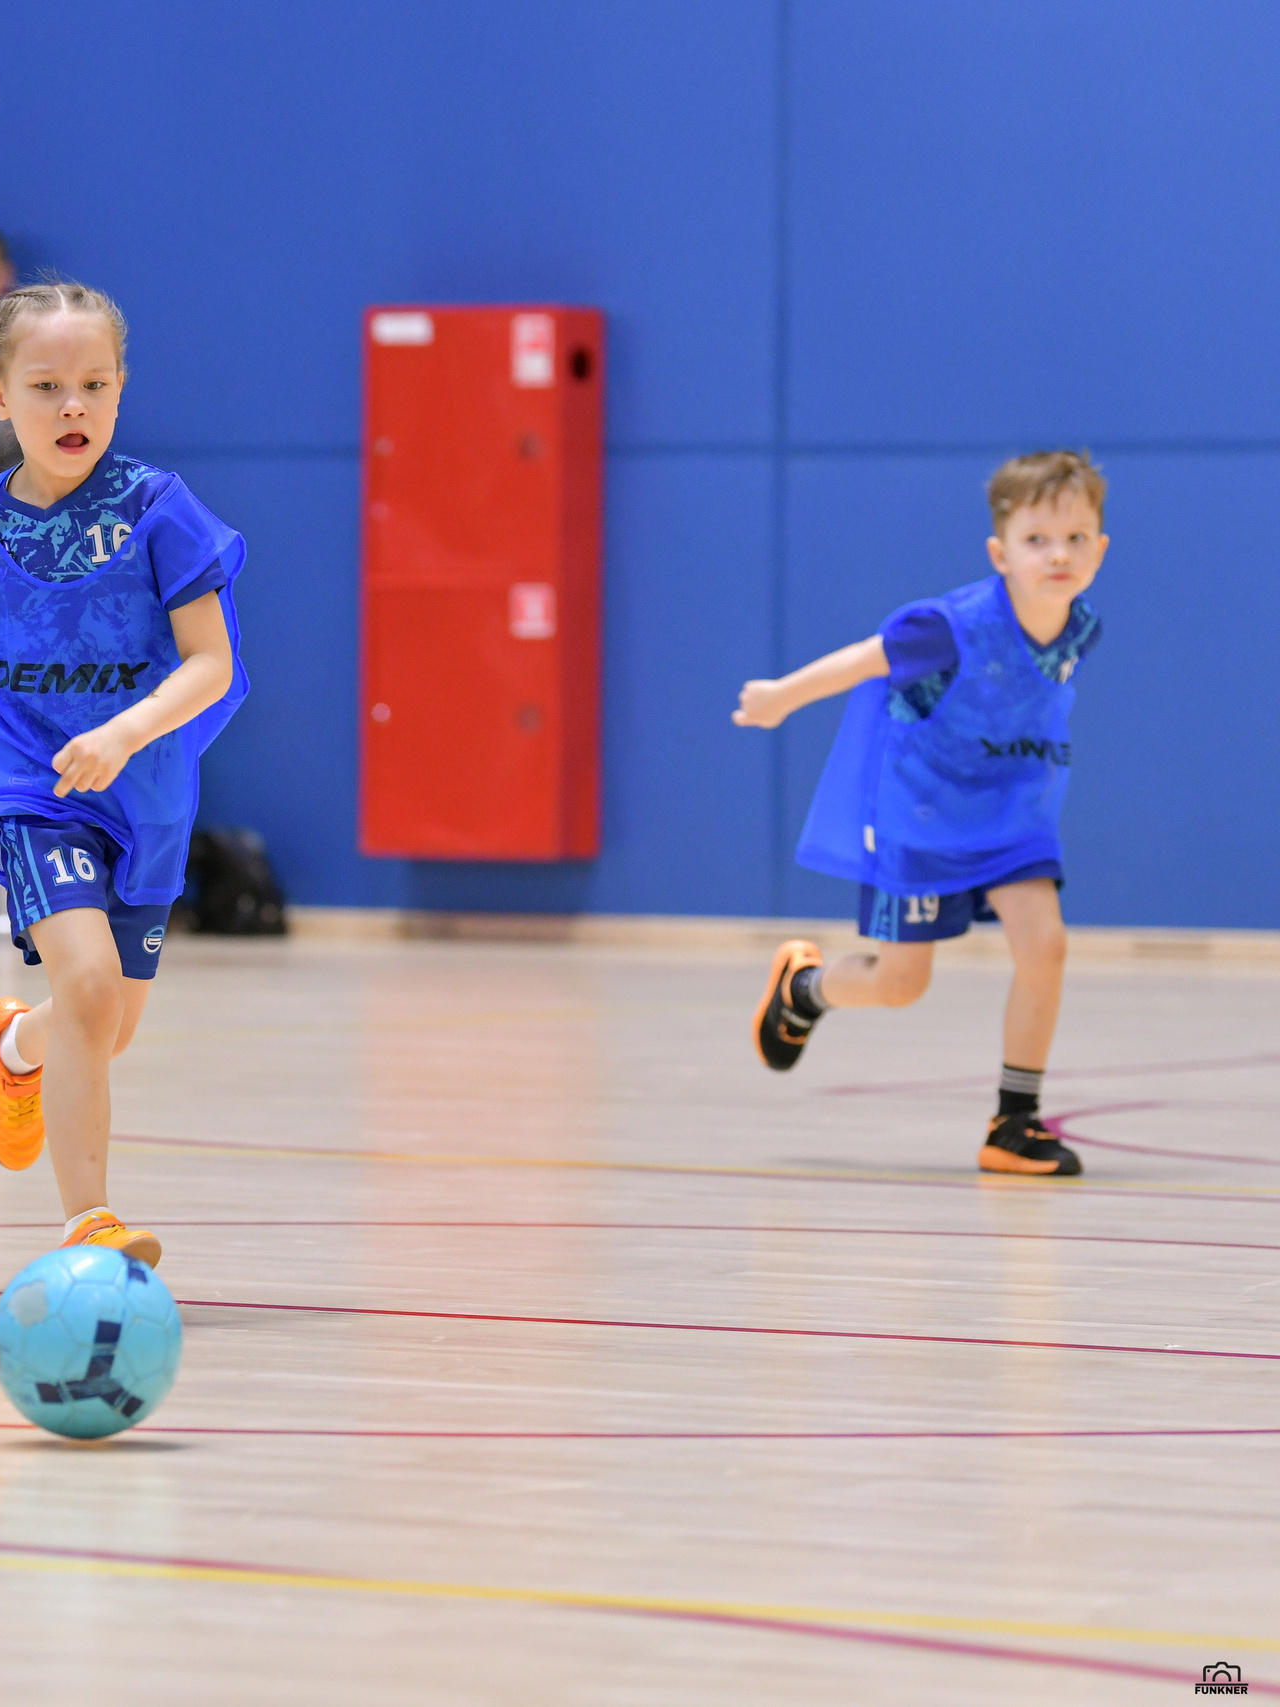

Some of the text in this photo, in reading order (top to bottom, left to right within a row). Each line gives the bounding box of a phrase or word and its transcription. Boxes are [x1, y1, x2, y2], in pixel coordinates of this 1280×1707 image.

[85, 523, 136, 563] 16
[45, 847, 97, 885] 16
[905, 892, 939, 923] 19
